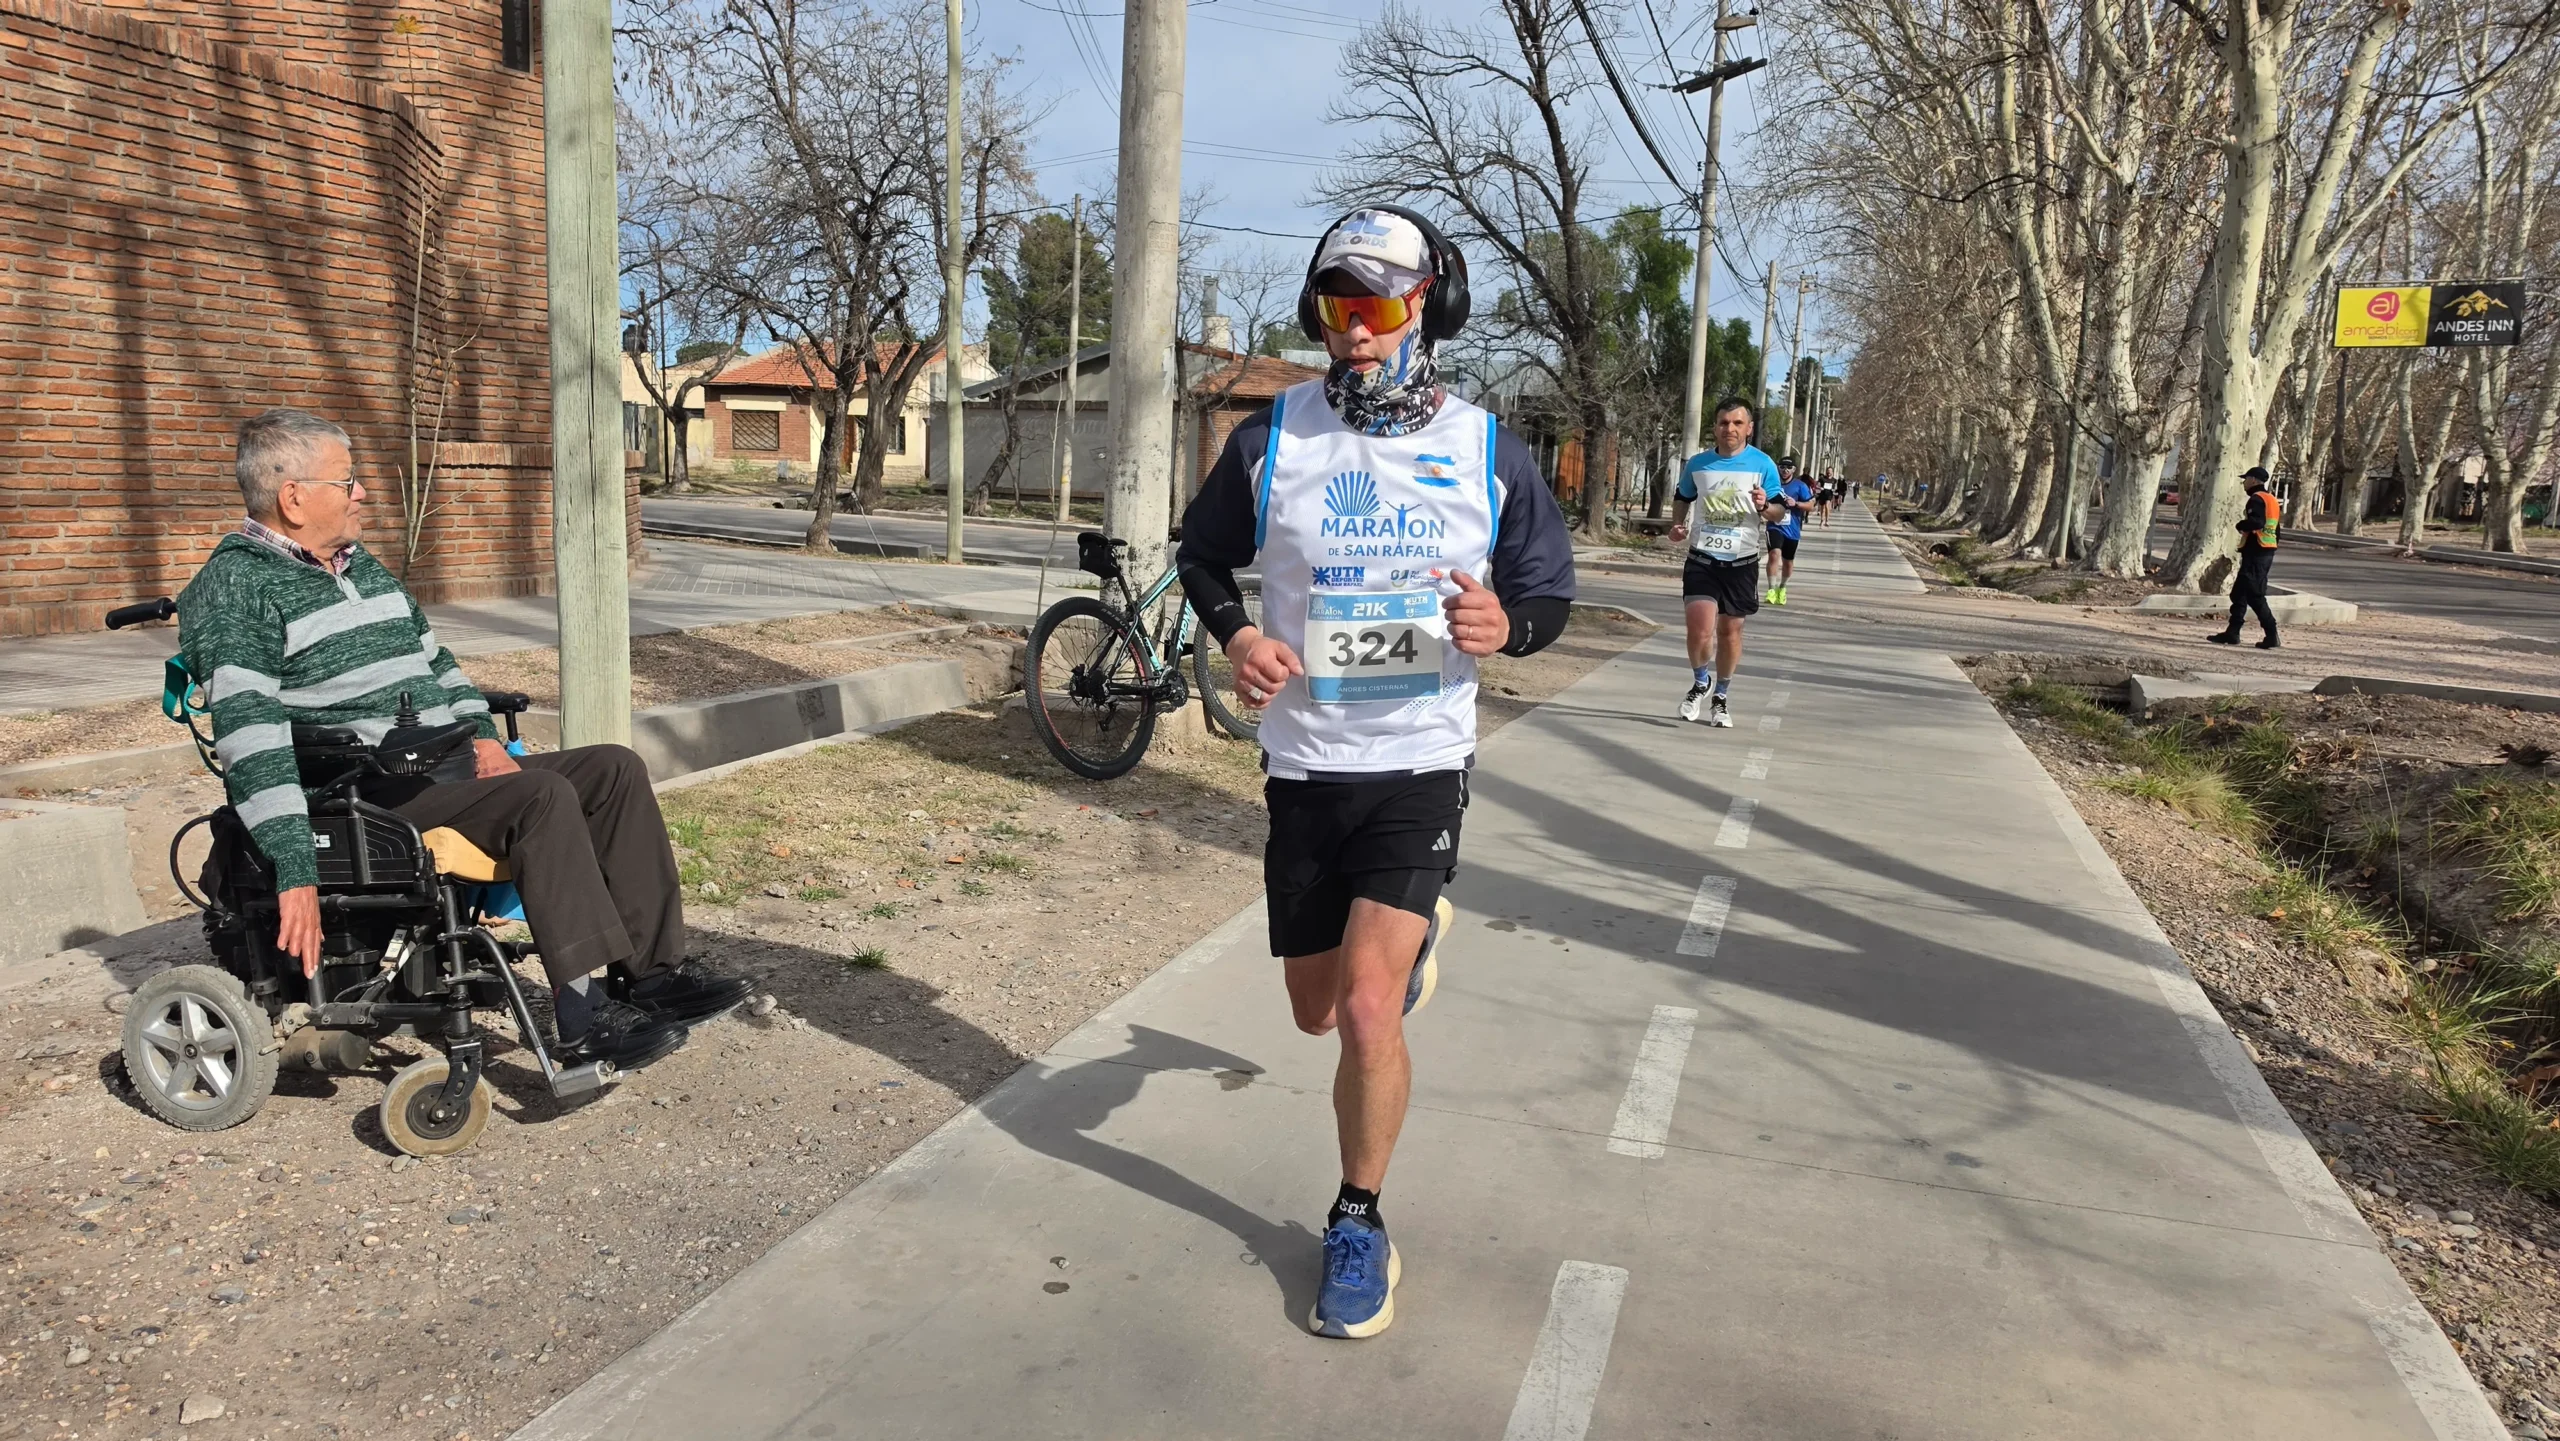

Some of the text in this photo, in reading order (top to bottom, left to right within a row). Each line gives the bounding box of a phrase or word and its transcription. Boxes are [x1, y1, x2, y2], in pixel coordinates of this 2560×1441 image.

[2434, 320, 2485, 333] ANDES
[2454, 333, 2491, 342] HOTEL
[1704, 536, 1732, 550] 293
[1328, 544, 1443, 559] DE SAN RAFAEL
[1331, 566, 1365, 578] UTN
[1352, 602, 1389, 617] 21K
[1328, 629, 1418, 667] 324
[1368, 684, 1409, 692] CISTERNAS
[1339, 1197, 1368, 1216] SOX
